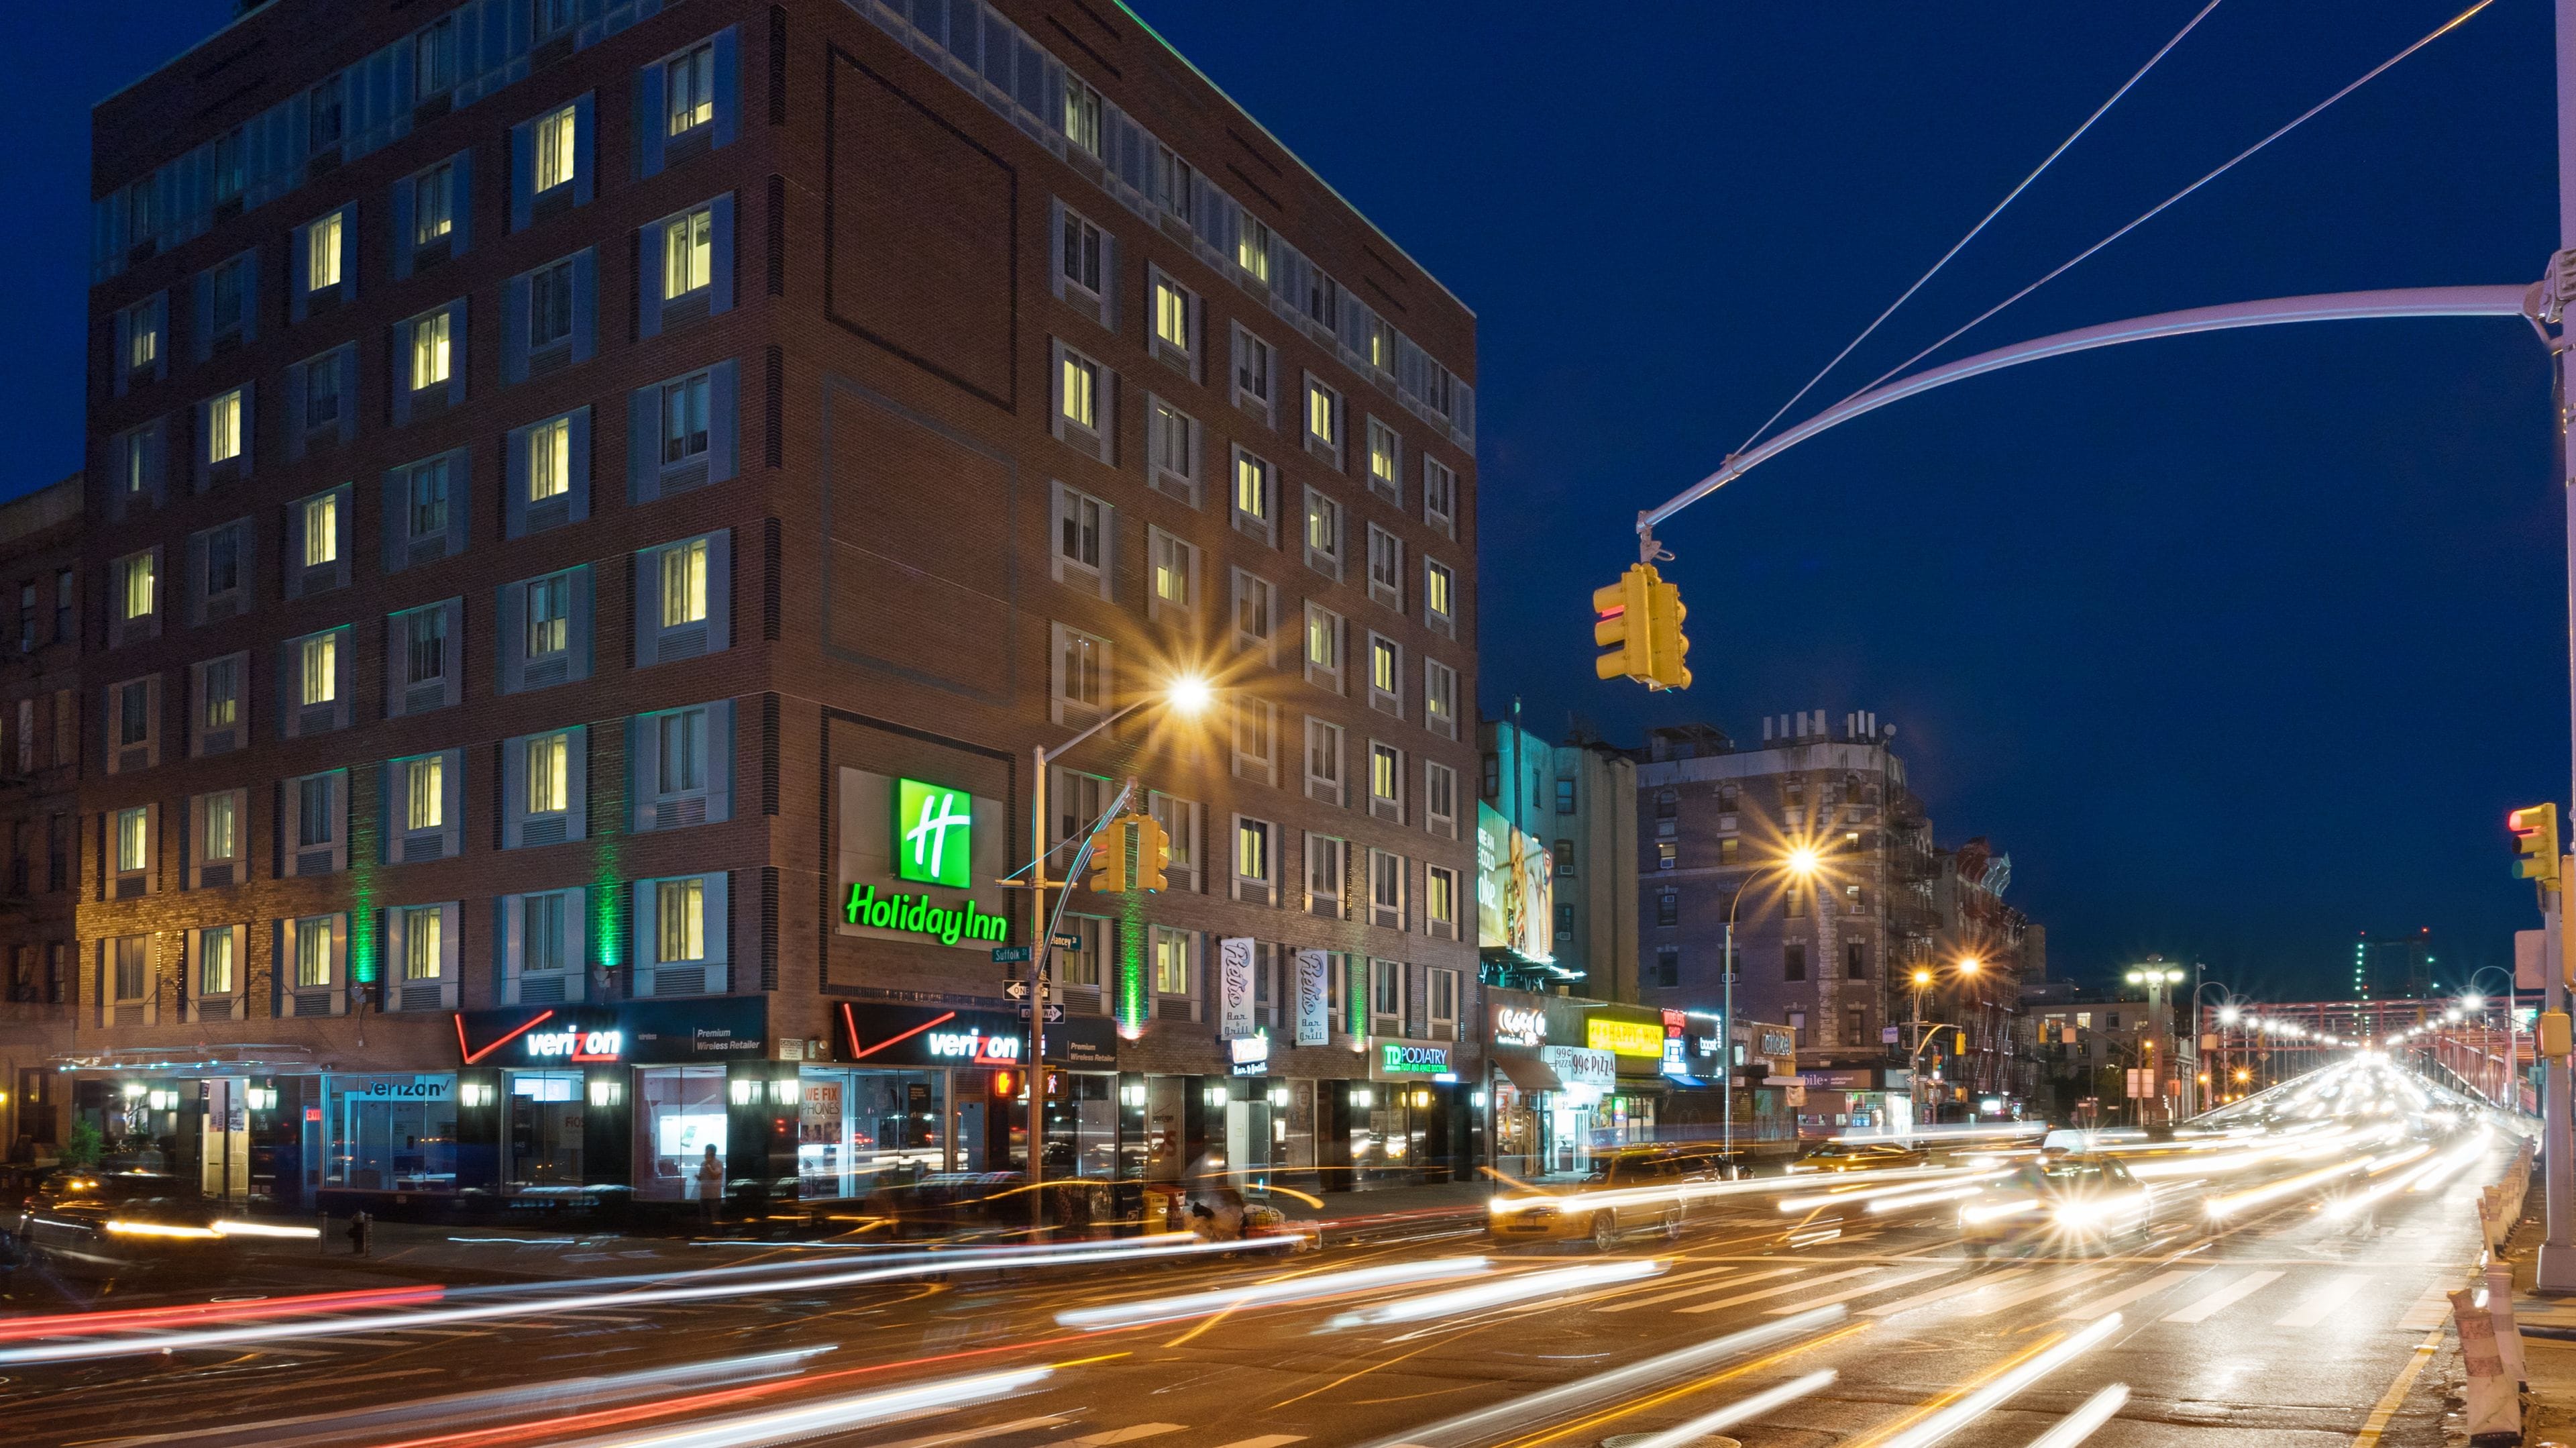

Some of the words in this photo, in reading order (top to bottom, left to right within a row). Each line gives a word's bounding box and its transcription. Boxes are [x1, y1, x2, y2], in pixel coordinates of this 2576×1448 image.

[1481, 848, 1496, 872] COLD
[847, 882, 963, 945] Holiday
[965, 900, 1008, 942] Inn
[996, 950, 1020, 961] Suffolk
[1224, 941, 1250, 1009] Retro
[1299, 953, 1324, 1016] Retro
[1227, 1012, 1248, 1021] Bar
[1301, 1019, 1322, 1027] Bar
[697, 1029, 731, 1038] Premium
[1224, 1027, 1251, 1037] Grill
[1299, 1031, 1325, 1042] Grill
[1609, 1024, 1638, 1043] HAPPY
[1643, 1027, 1660, 1045] WOK
[528, 1025, 621, 1062] verizon
[697, 1041, 729, 1051] Wireless
[730, 1040, 760, 1050] Retailer
[929, 1029, 1019, 1065] verizon
[1071, 1043, 1096, 1051] Premium
[1700, 1037, 1717, 1051] boost
[1764, 1031, 1792, 1055] cricket
[1071, 1053, 1093, 1062] Wireless
[1094, 1054, 1116, 1063] Retailer
[1385, 1045, 1401, 1065] TD
[1401, 1047, 1447, 1064] PODIATRY
[1556, 1047, 1572, 1058] 99¢
[1555, 1059, 1572, 1068] PIZZA
[1572, 1053, 1589, 1074] 99¢
[1591, 1055, 1615, 1076] PIZZA
[1802, 1074, 1823, 1086] bile
[804, 1087, 820, 1101] WE
[822, 1087, 838, 1101] FIX
[801, 1102, 839, 1115] PHONES
[307, 1110, 321, 1120] EXIT
